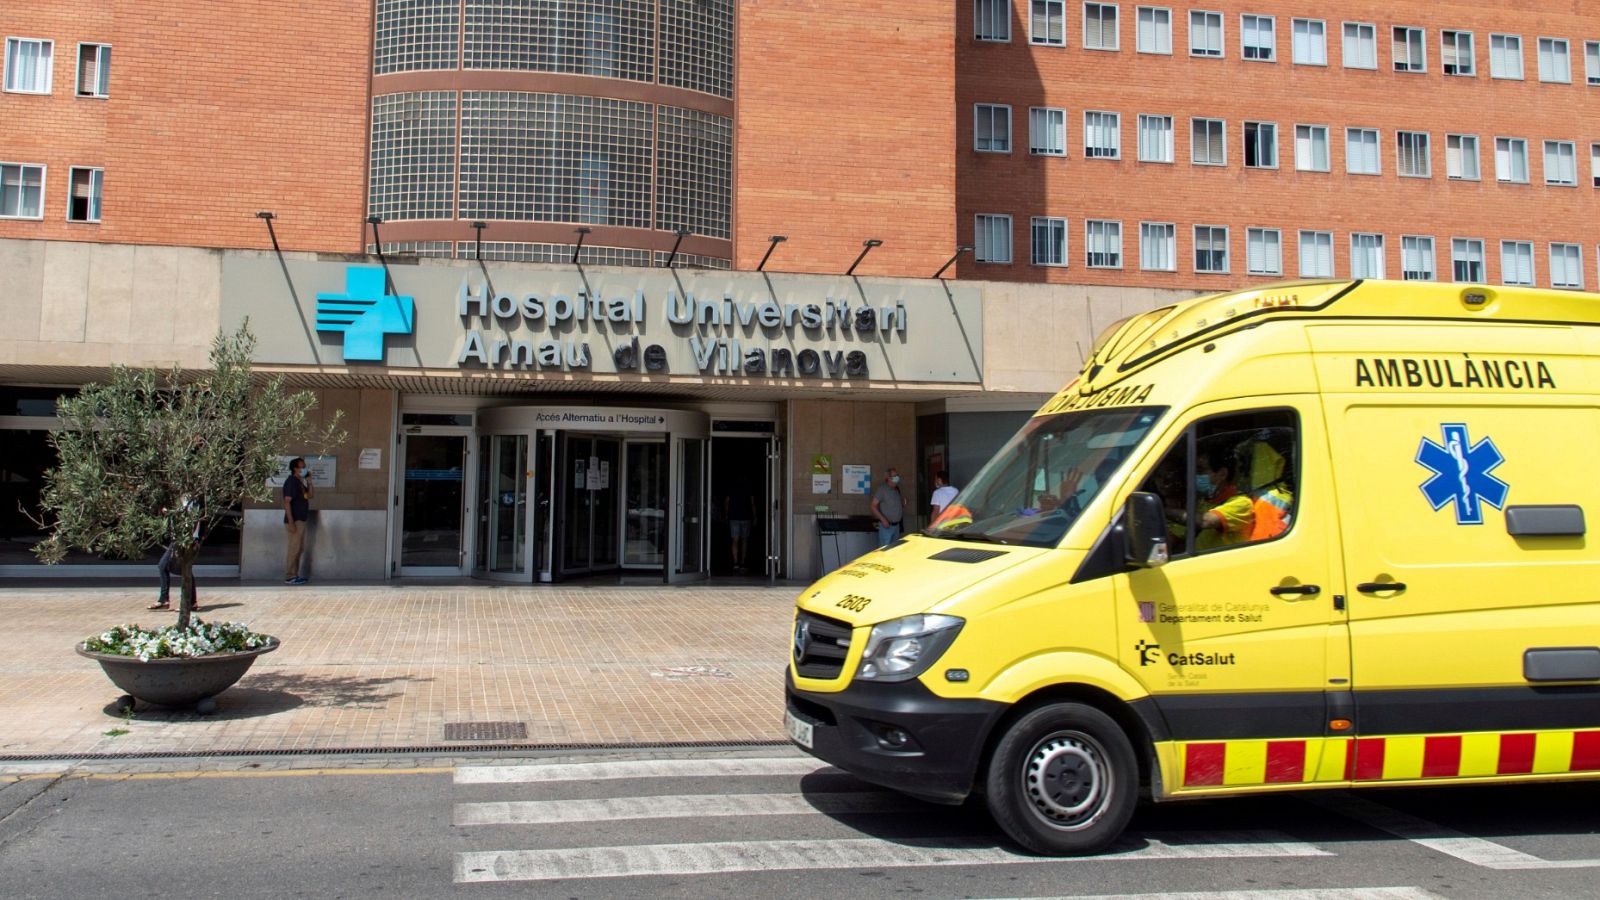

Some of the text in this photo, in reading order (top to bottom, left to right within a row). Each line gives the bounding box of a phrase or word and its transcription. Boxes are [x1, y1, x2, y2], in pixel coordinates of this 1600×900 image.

[459, 281, 907, 332] Hospital Universitari
[458, 329, 868, 375] Arnau de Vilanova
[1356, 353, 1556, 388] AMBULÀNCIA
[536, 412, 656, 425] Accés Alternatiu a l'Hospital
[836, 594, 872, 613] 2603
[1159, 602, 1270, 613] Generalitat de Catalunya
[1159, 613, 1262, 625] Departament de Salut
[1168, 652, 1235, 666] CatSalut
